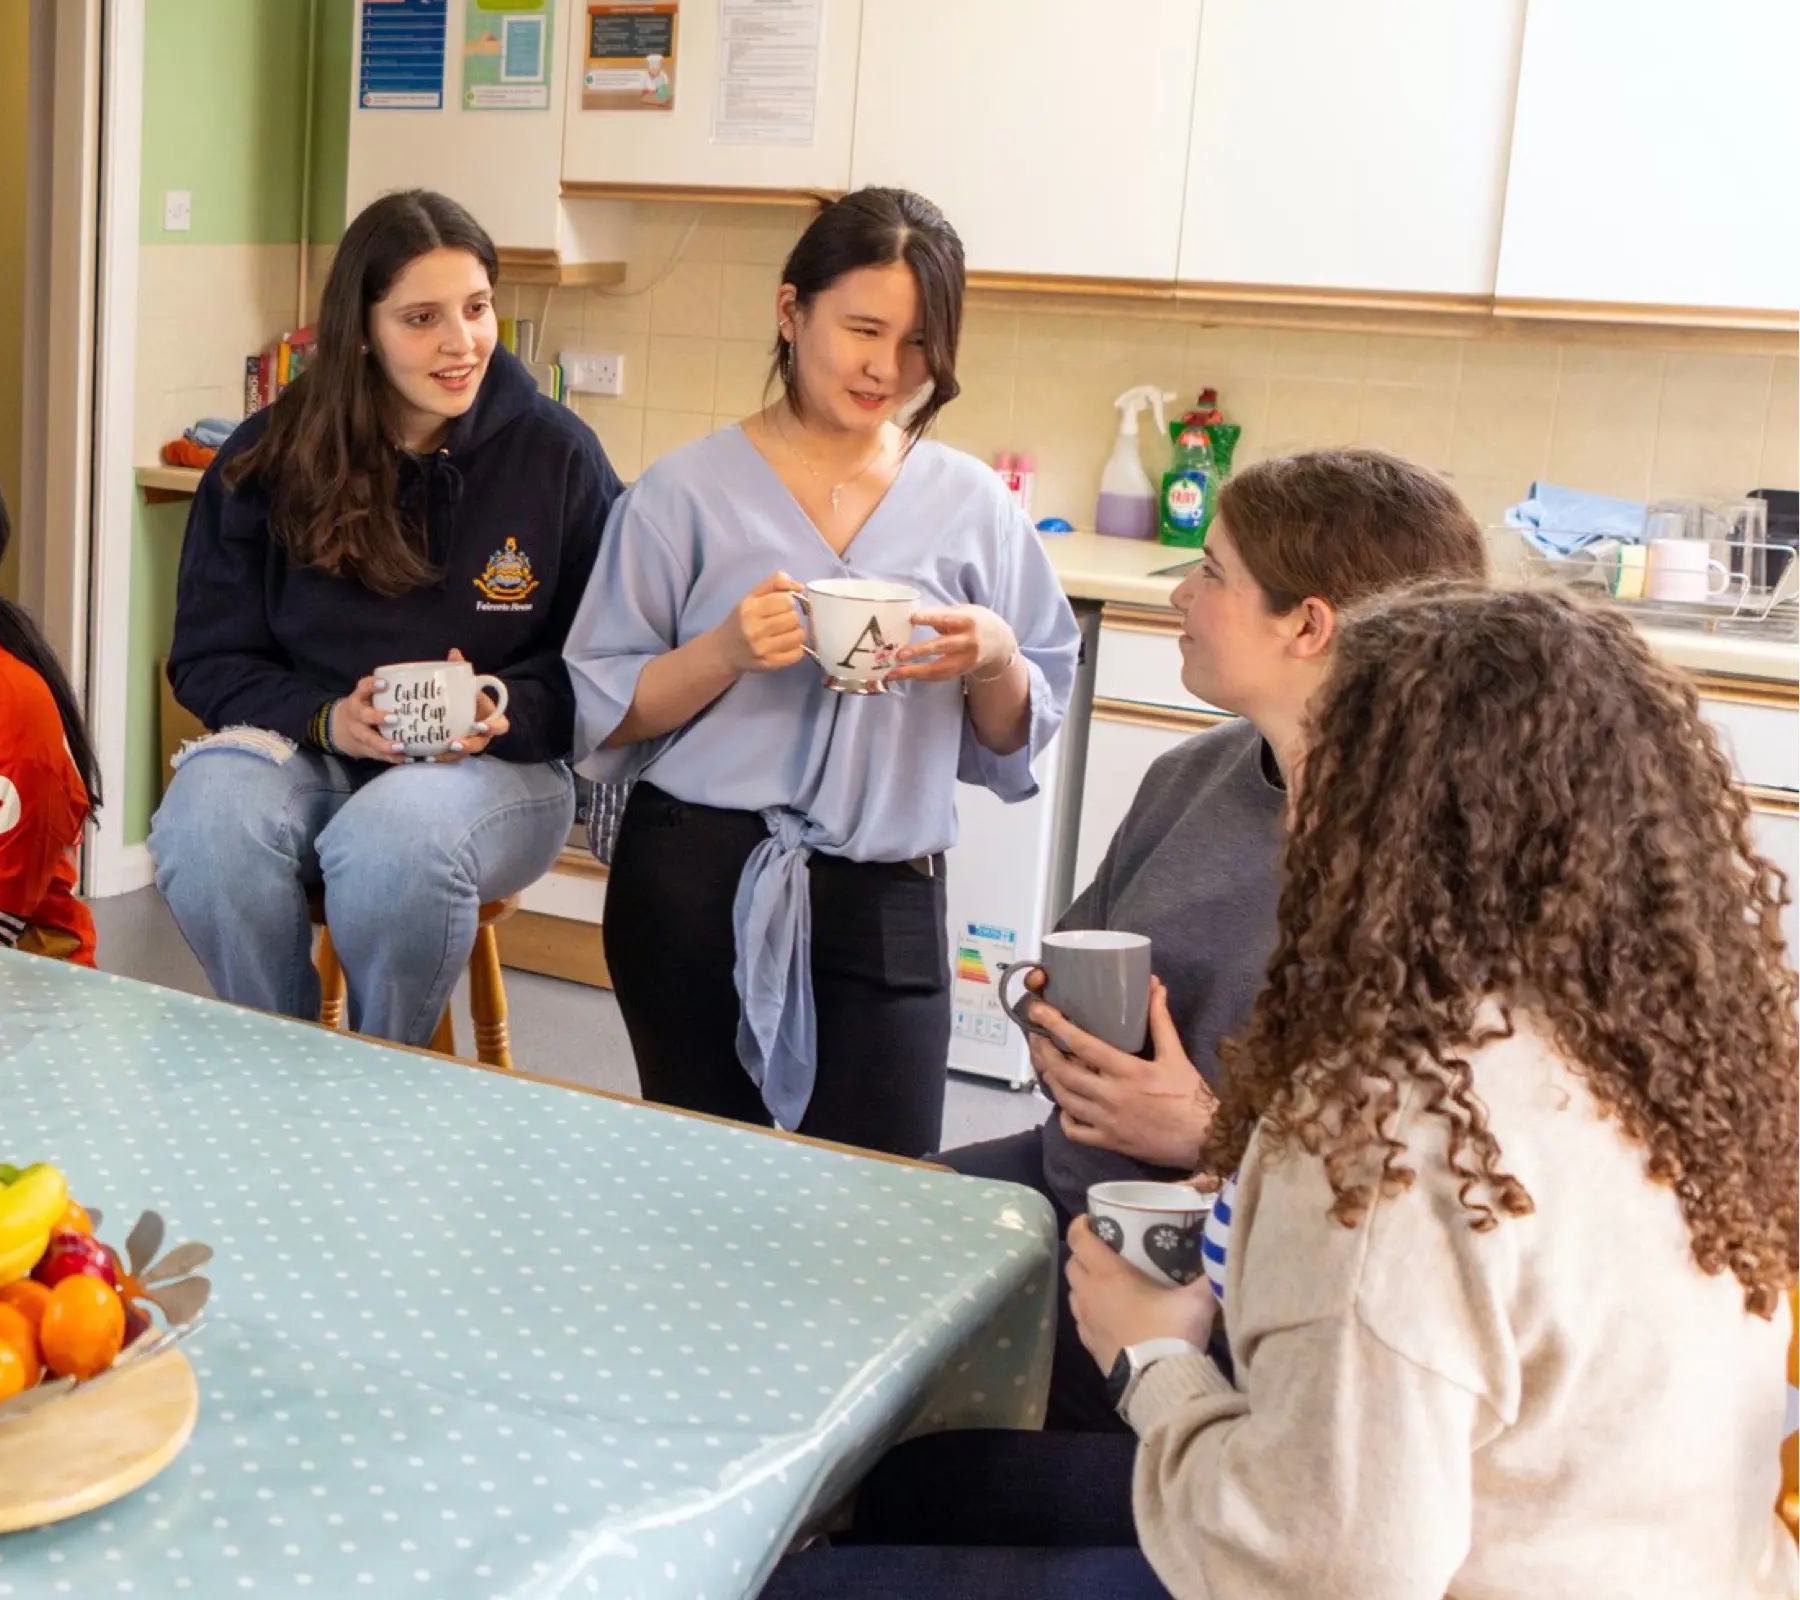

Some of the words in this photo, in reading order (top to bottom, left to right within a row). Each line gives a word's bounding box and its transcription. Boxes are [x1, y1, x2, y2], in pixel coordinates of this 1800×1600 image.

[836, 614, 893, 671] A
[395, 679, 441, 702] Cuddle
[421, 703, 447, 723] Cup
